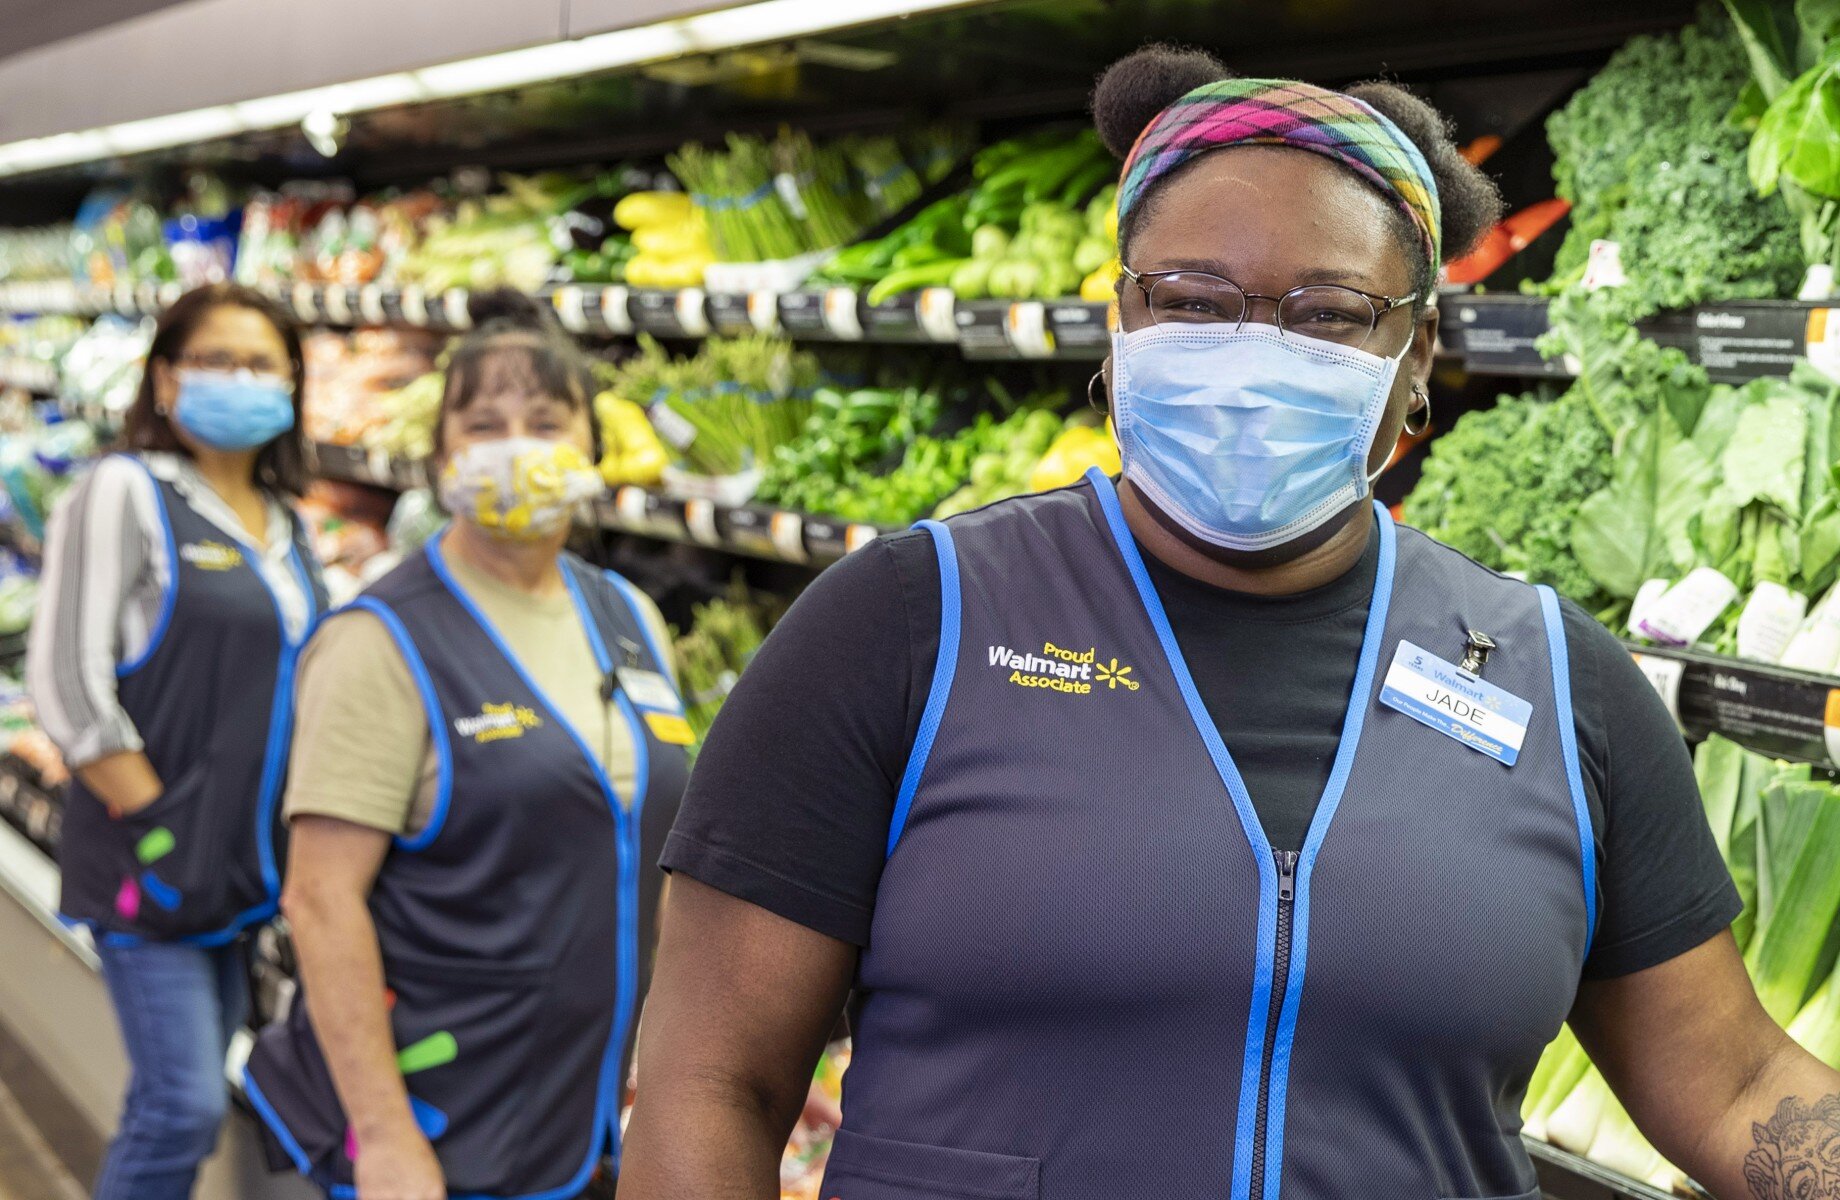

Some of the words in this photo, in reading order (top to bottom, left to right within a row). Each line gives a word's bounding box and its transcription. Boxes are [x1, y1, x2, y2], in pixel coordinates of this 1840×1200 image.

[988, 645, 1092, 680] Walmart
[1043, 642, 1095, 664] Proud
[1413, 655, 1423, 666] 5
[1009, 670, 1091, 694] Associate
[1434, 669, 1484, 701] Walmart
[1426, 689, 1486, 726] JADE
[1392, 696, 1403, 705] Our
[1403, 701, 1422, 714] People
[1421, 711, 1437, 722] Make
[1451, 723, 1503, 753] Difference
